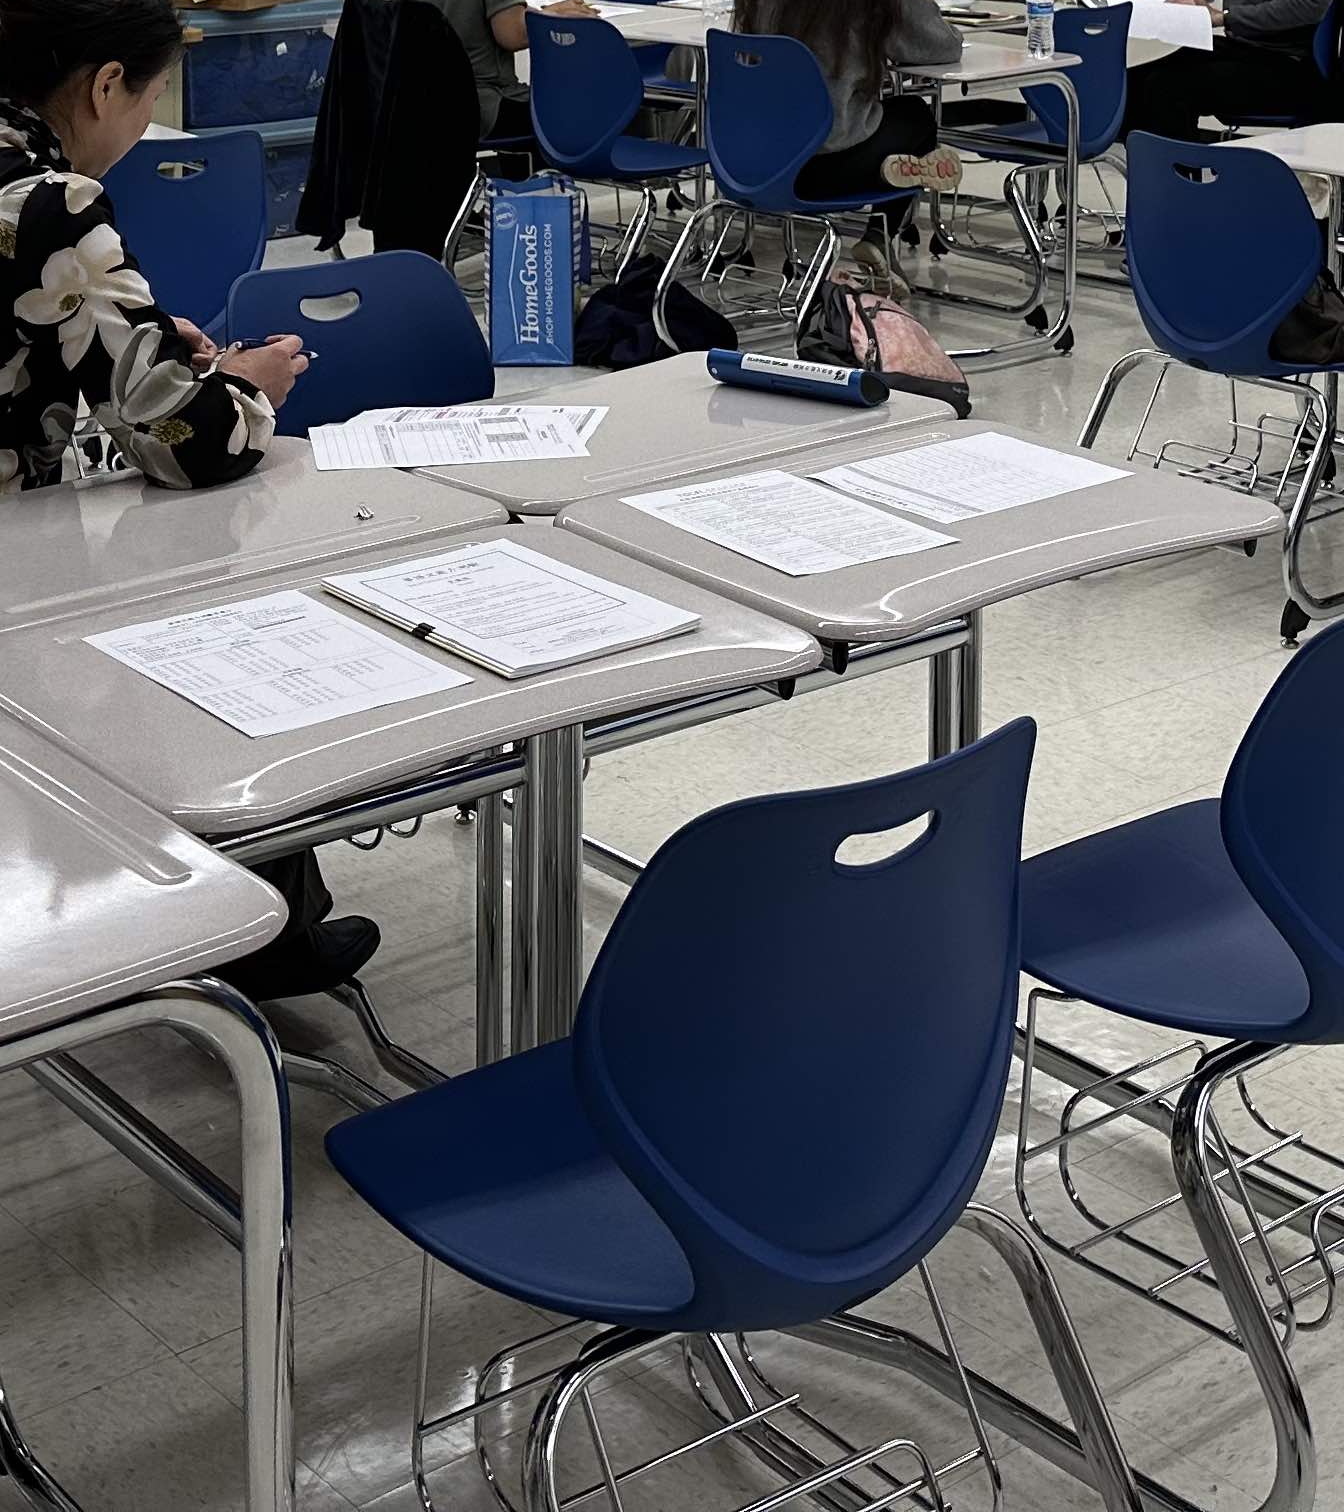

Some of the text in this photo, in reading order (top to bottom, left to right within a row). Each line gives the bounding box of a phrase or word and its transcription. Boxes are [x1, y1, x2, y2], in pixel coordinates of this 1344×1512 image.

[519, 224, 540, 345] HomeGoods
[543, 223, 554, 345] SHOP HOMEGOODS.COM
